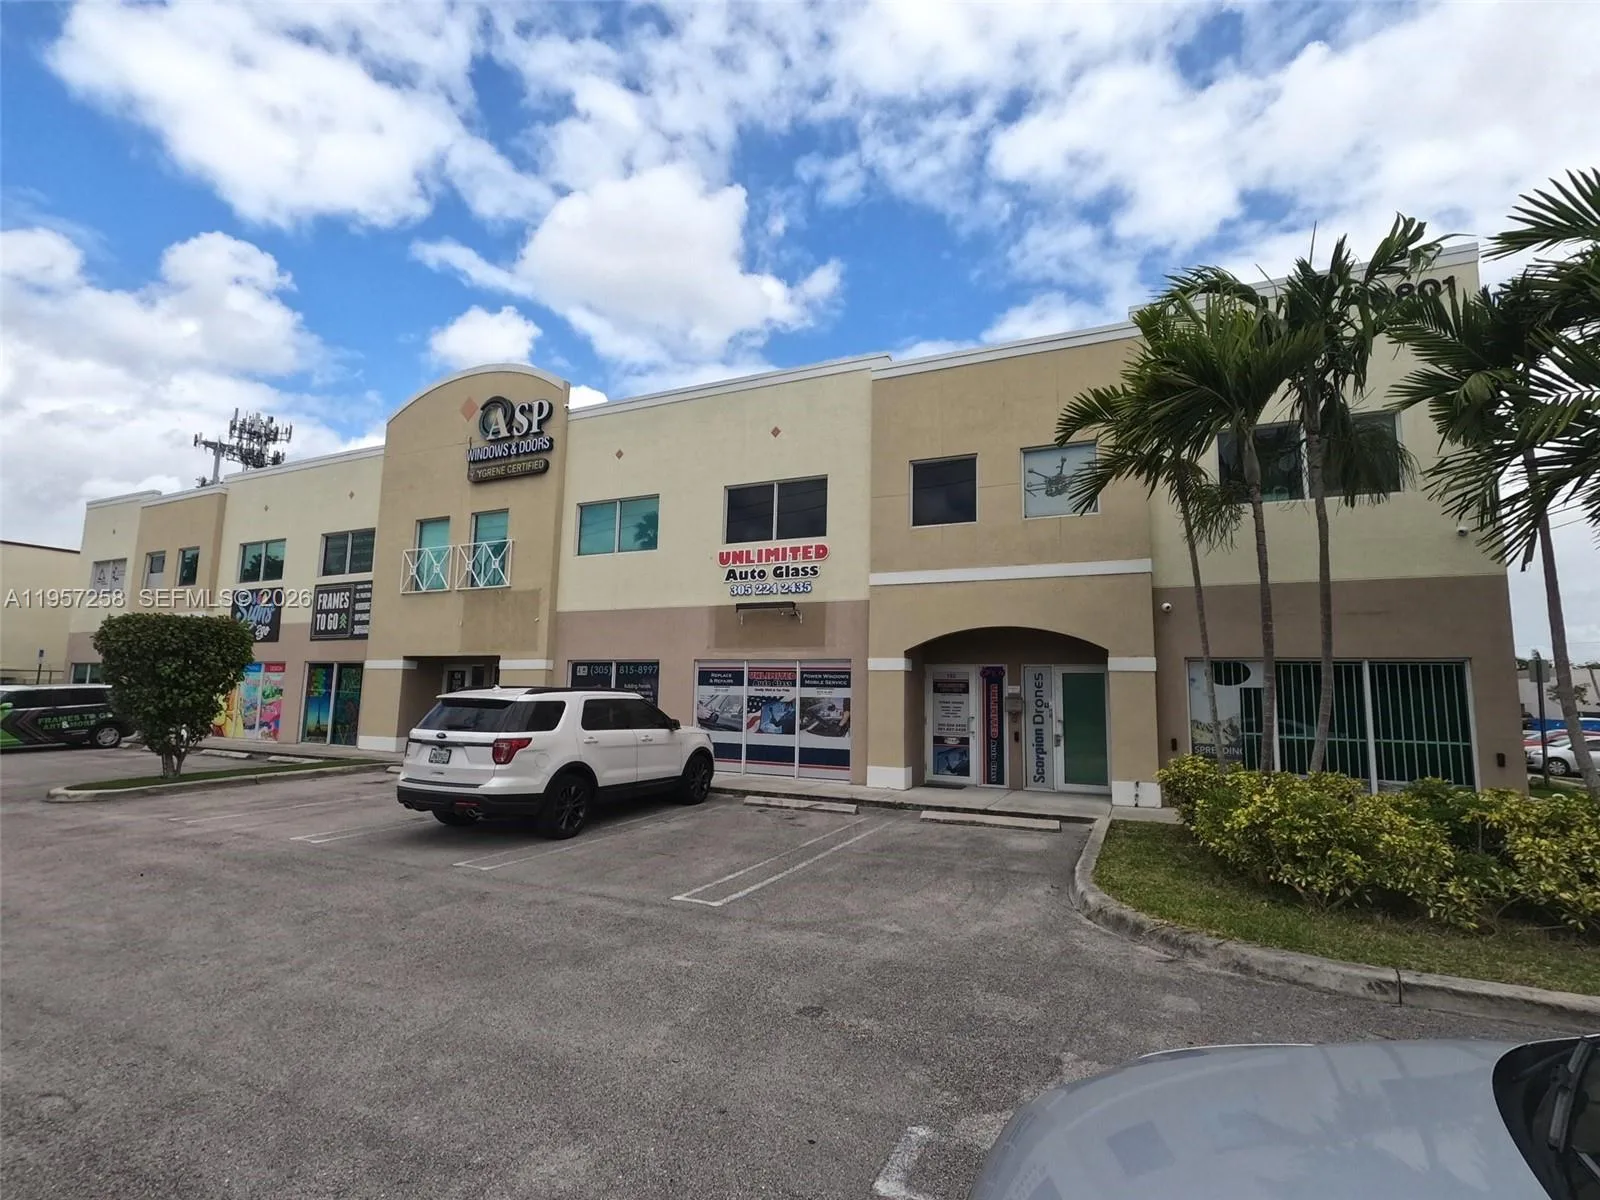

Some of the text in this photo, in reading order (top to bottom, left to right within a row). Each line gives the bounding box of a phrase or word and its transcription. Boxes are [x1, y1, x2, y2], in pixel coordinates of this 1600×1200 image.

[480, 396, 553, 441] ASP
[467, 436, 551, 462] WINDOWS & DOORS
[477, 459, 544, 478] YGRENE CERTIFIED
[718, 544, 829, 566] UNLIMITED
[725, 565, 819, 581] Auto Glass
[730, 581, 812, 595] 305 224 2435
[317, 591, 350, 610] FRAMES
[316, 613, 326, 631] TO
[327, 612, 338, 630] GO
[590, 665, 658, 676] (305) 815-8997
[1032, 672, 1047, 783] Scorpion Drones
[1194, 744, 1243, 755] SPREDIN
